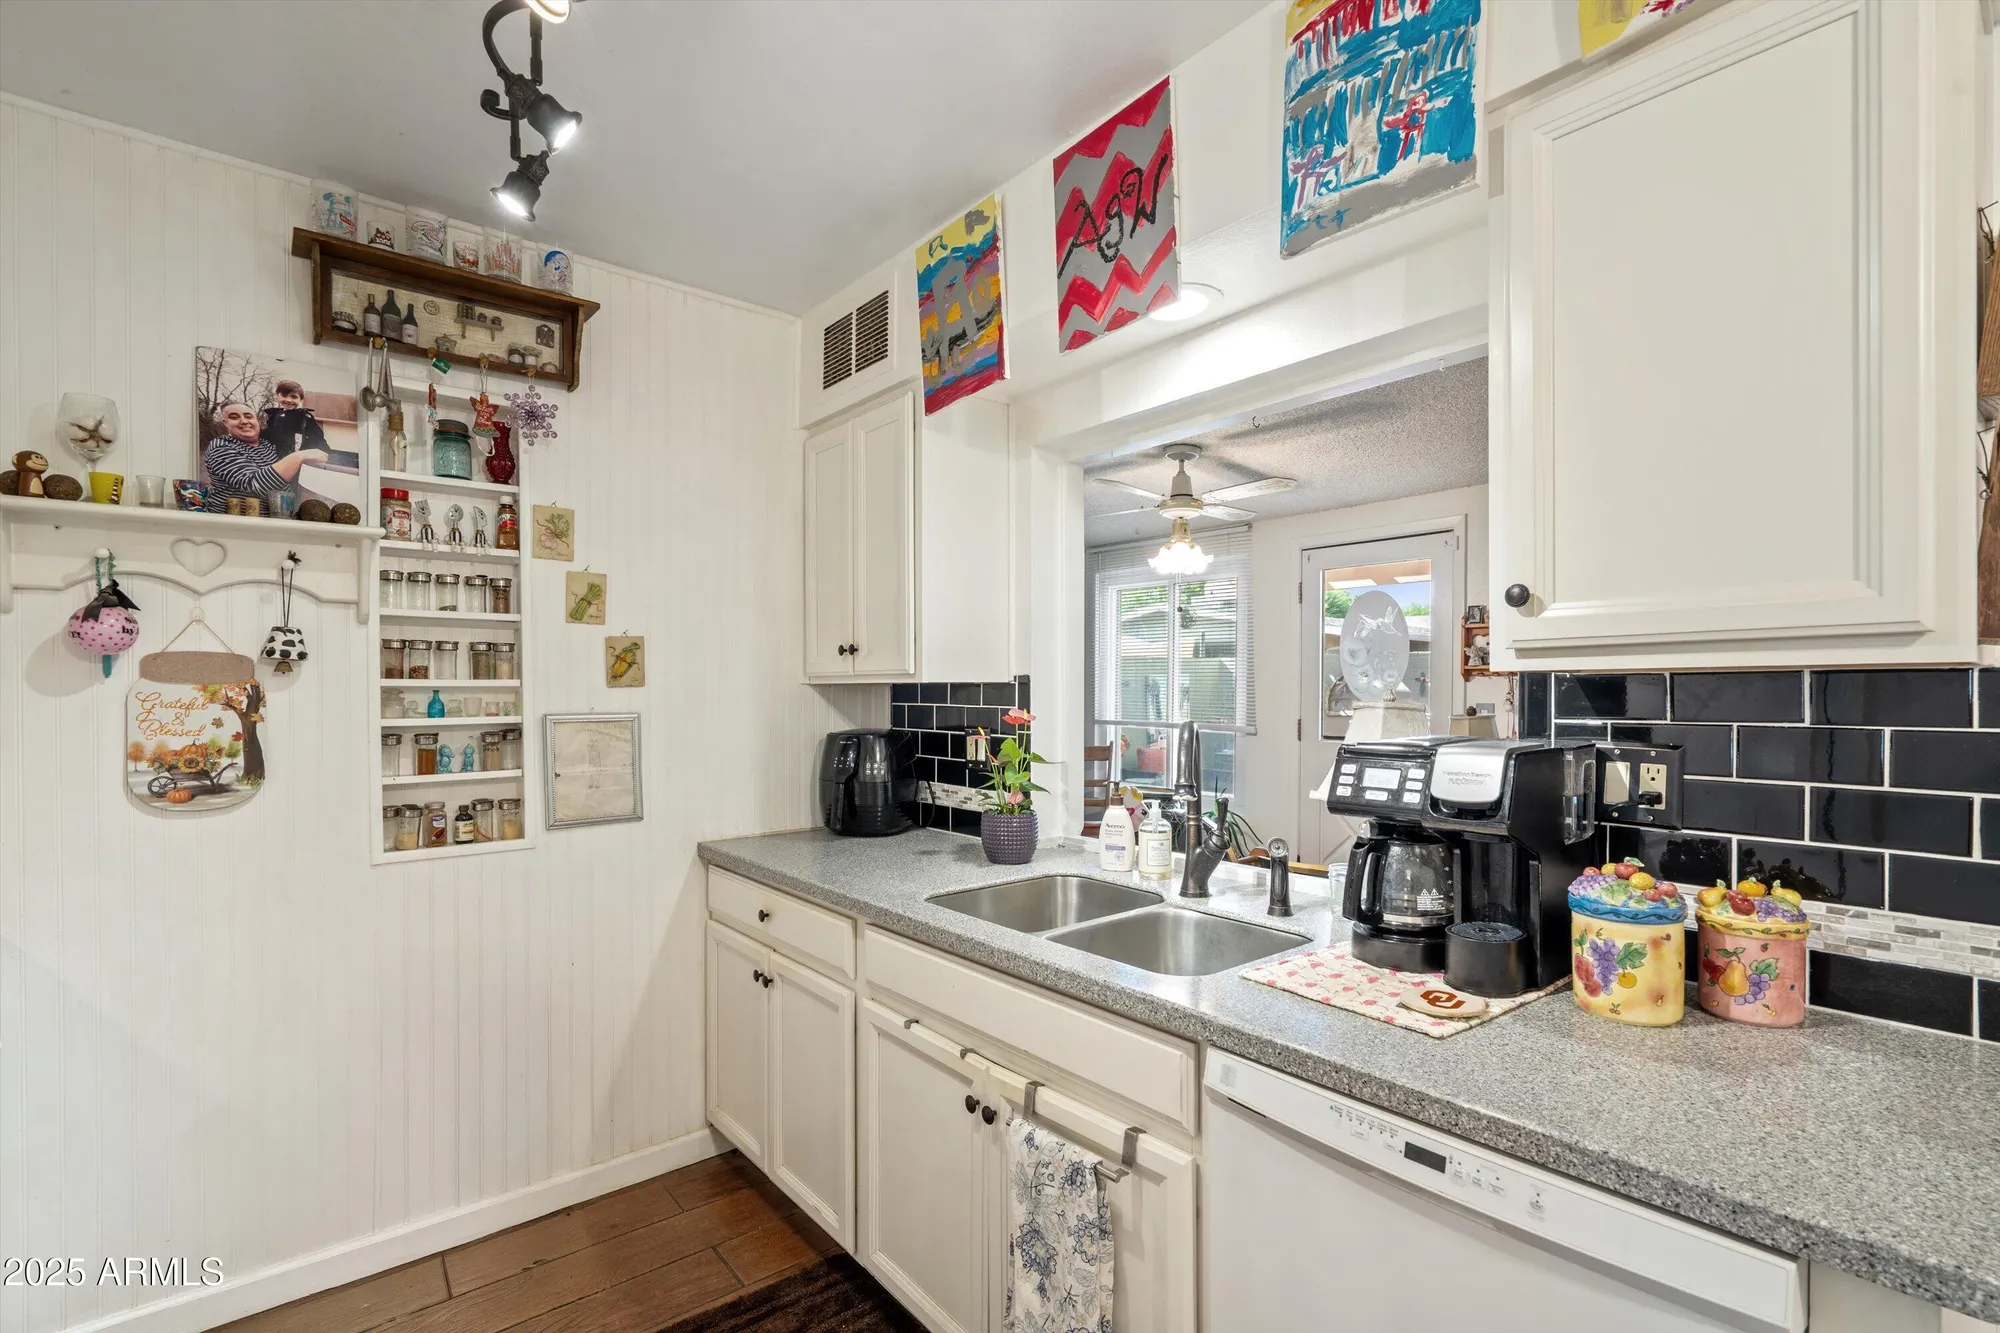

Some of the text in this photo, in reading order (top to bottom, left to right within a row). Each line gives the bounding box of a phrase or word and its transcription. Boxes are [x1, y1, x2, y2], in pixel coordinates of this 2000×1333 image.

[135, 691, 209, 718] Grateful
[136, 711, 206, 741] Blessed
[172, 711, 185, 727] &
